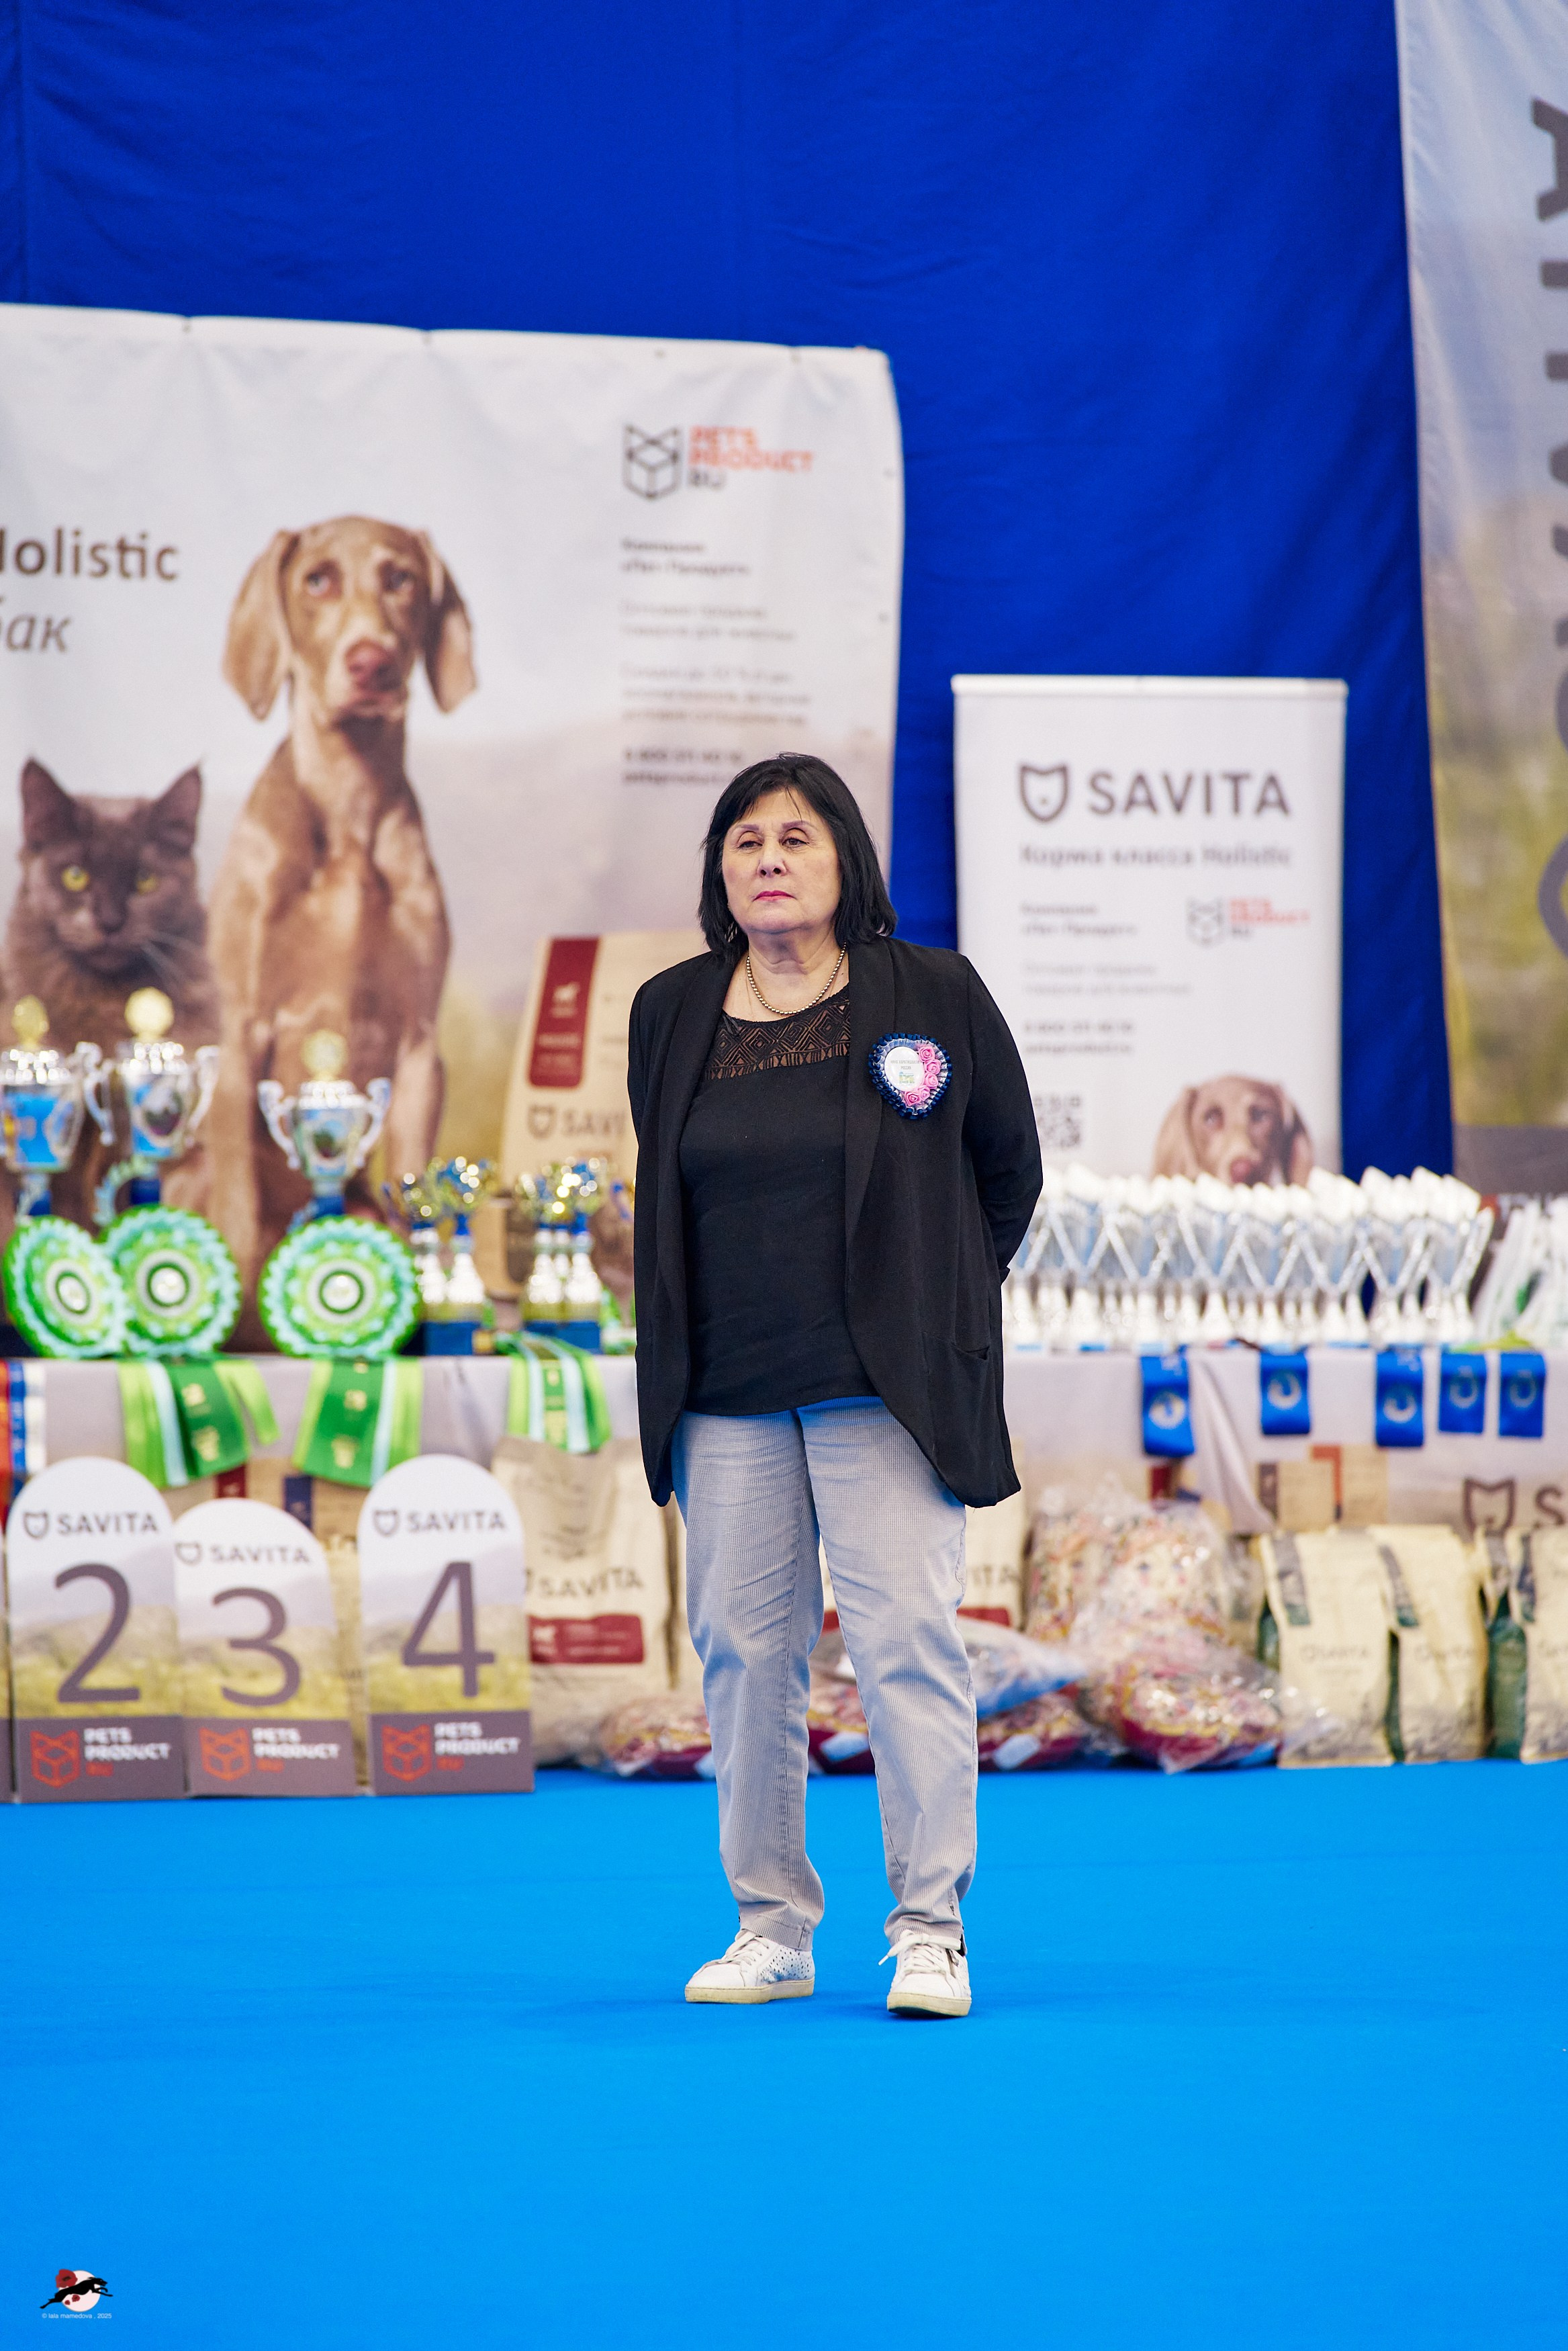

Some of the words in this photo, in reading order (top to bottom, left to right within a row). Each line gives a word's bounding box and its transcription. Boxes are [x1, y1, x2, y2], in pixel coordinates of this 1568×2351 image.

[0, 595, 71, 653] ак
[1088, 771, 1291, 816] SAVITA
[57, 1511, 159, 1536] SAVITA
[406, 1509, 506, 1534] SAVITA
[210, 1544, 310, 1565] SAVITA
[539, 1567, 643, 1597] SAVITA
[54, 1562, 141, 1704] 2
[404, 1560, 496, 1697] 4
[212, 1586, 300, 1707] 3
[83, 1727, 132, 1744] PETS
[252, 1728, 301, 1743] PETS
[434, 1722, 482, 1738] PETS
[84, 1742, 171, 1761] PRODUCT
[254, 1742, 340, 1759] PRODUCT
[434, 1737, 521, 1755] PRODUCT
